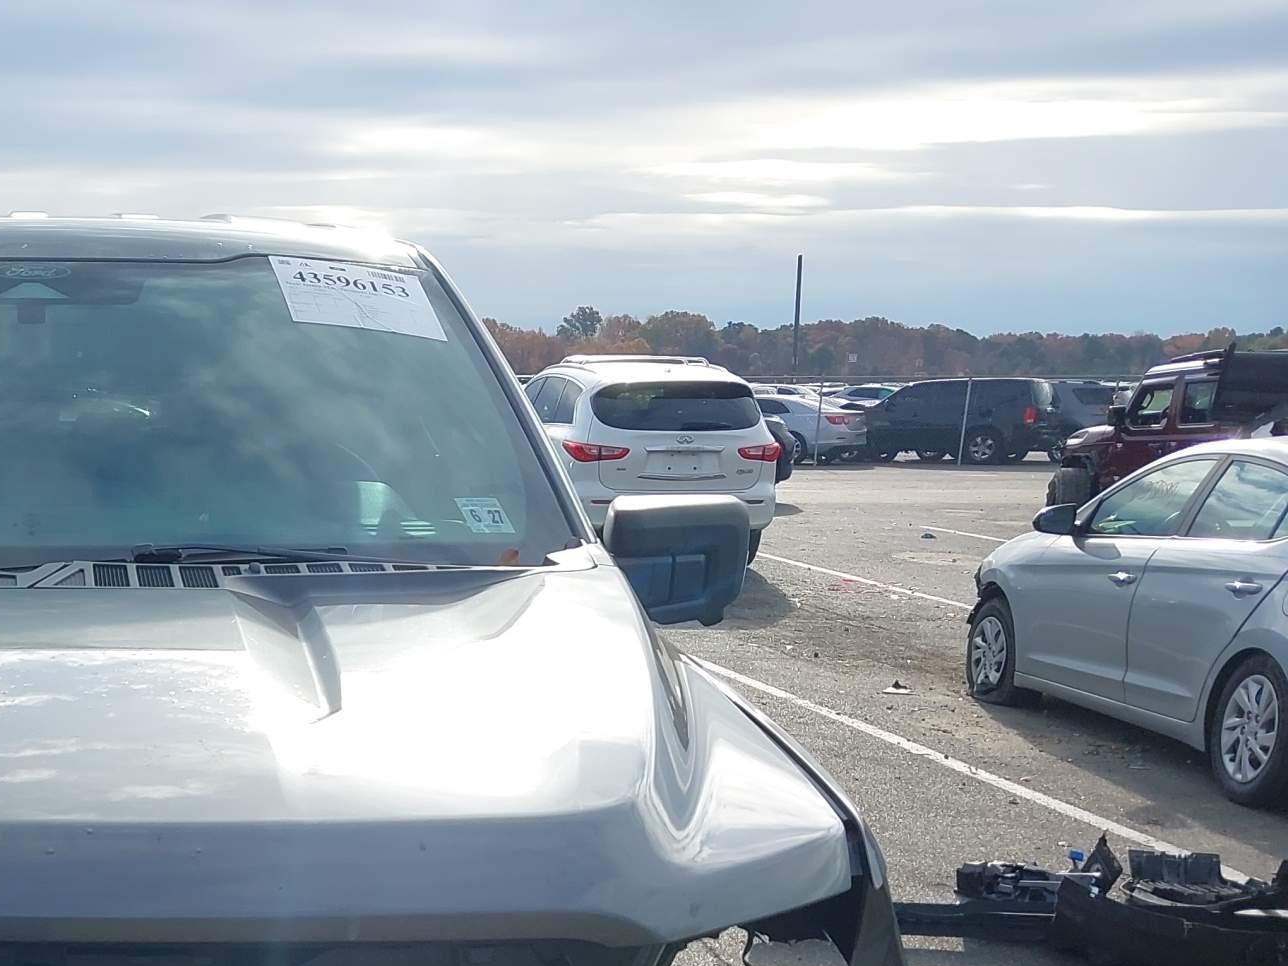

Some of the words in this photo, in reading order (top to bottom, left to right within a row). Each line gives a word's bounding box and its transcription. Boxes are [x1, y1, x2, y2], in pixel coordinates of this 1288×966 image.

[292, 270, 410, 298] 43596153
[469, 509, 482, 523] 6
[487, 509, 505, 524] 27
